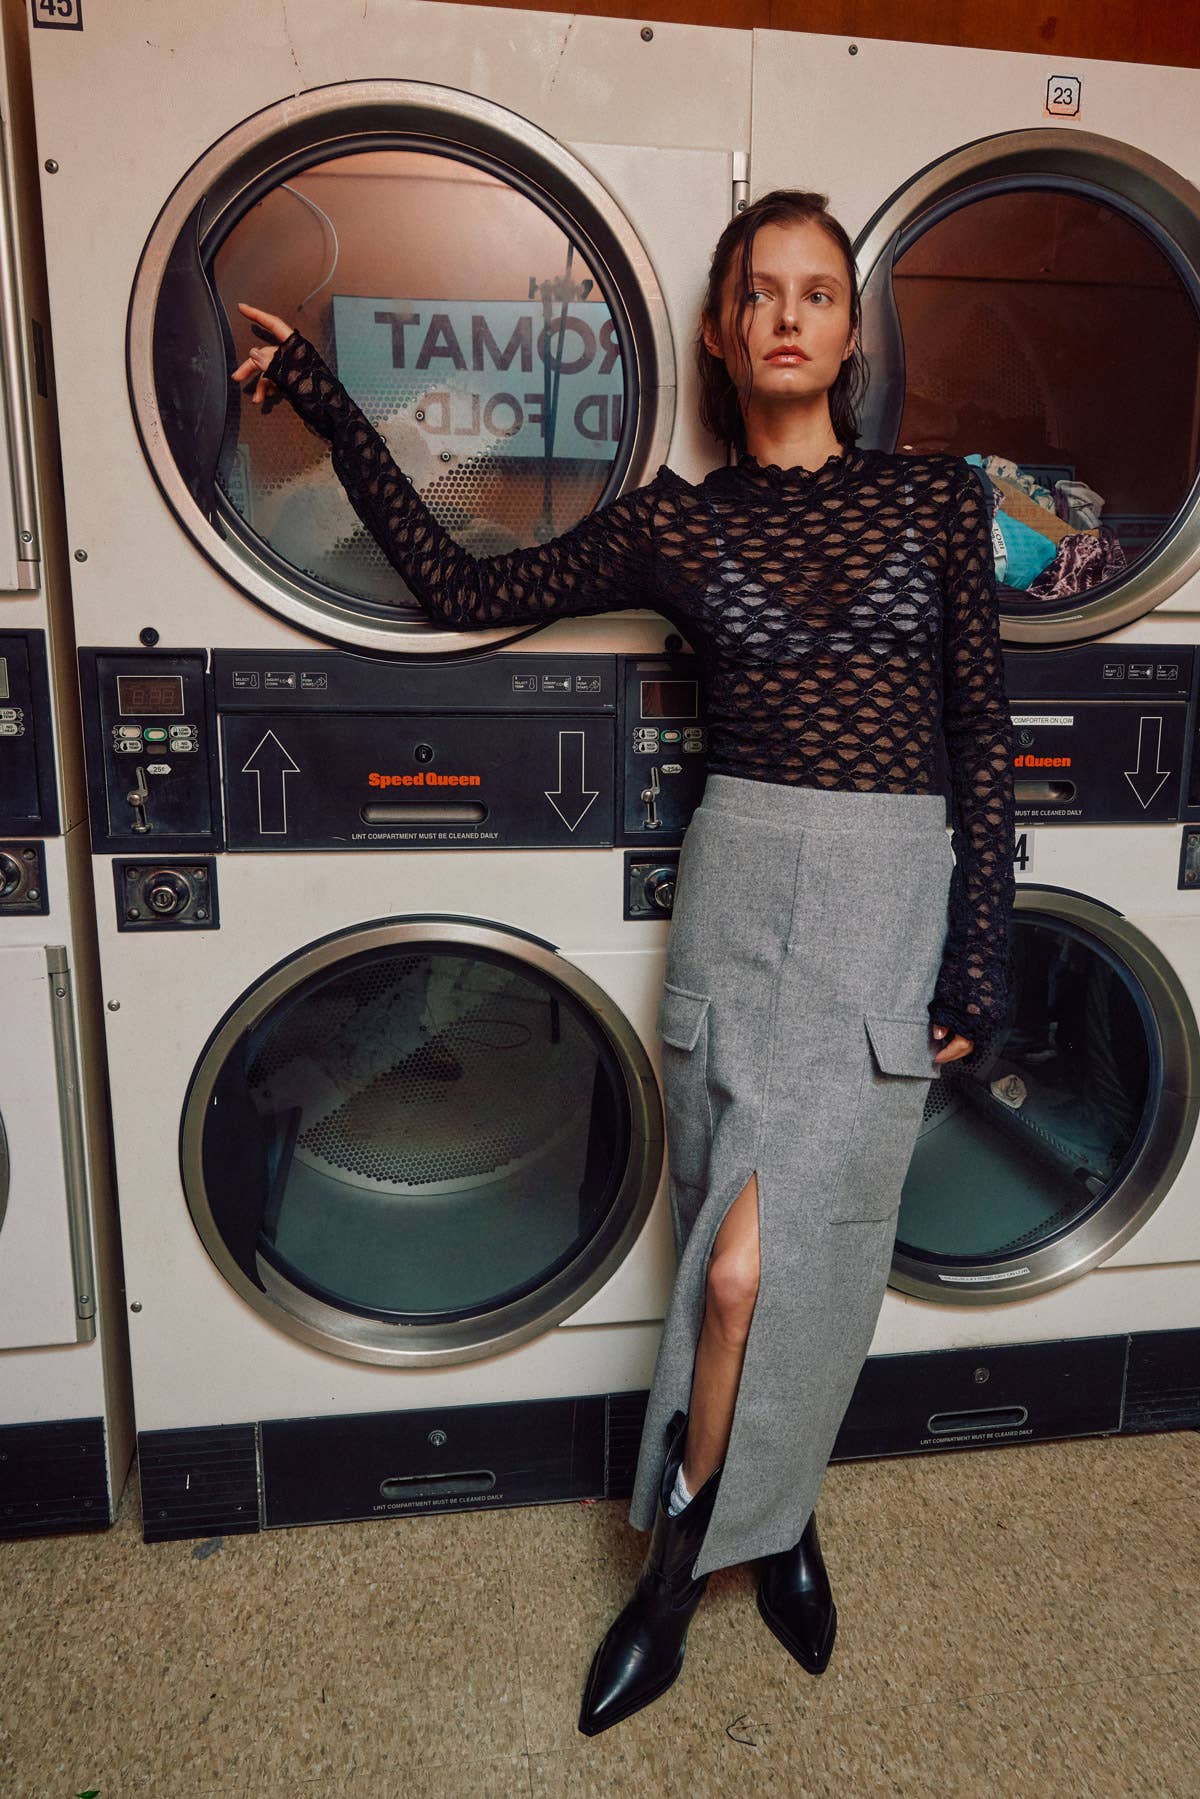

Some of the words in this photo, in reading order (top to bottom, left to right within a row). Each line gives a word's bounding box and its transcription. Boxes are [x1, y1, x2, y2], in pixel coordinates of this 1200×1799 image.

[40, 0, 72, 17] 45
[53, 87, 73, 105] 23
[1025, 754, 1072, 768] Queen
[368, 772, 424, 789] Speed
[425, 771, 481, 786] Queen
[367, 832, 417, 840] COMPARTMENT
[994, 1430, 1018, 1438] CLEANED
[387, 1500, 432, 1510] COMPARTMENT
[458, 1495, 486, 1503] CLEANED
